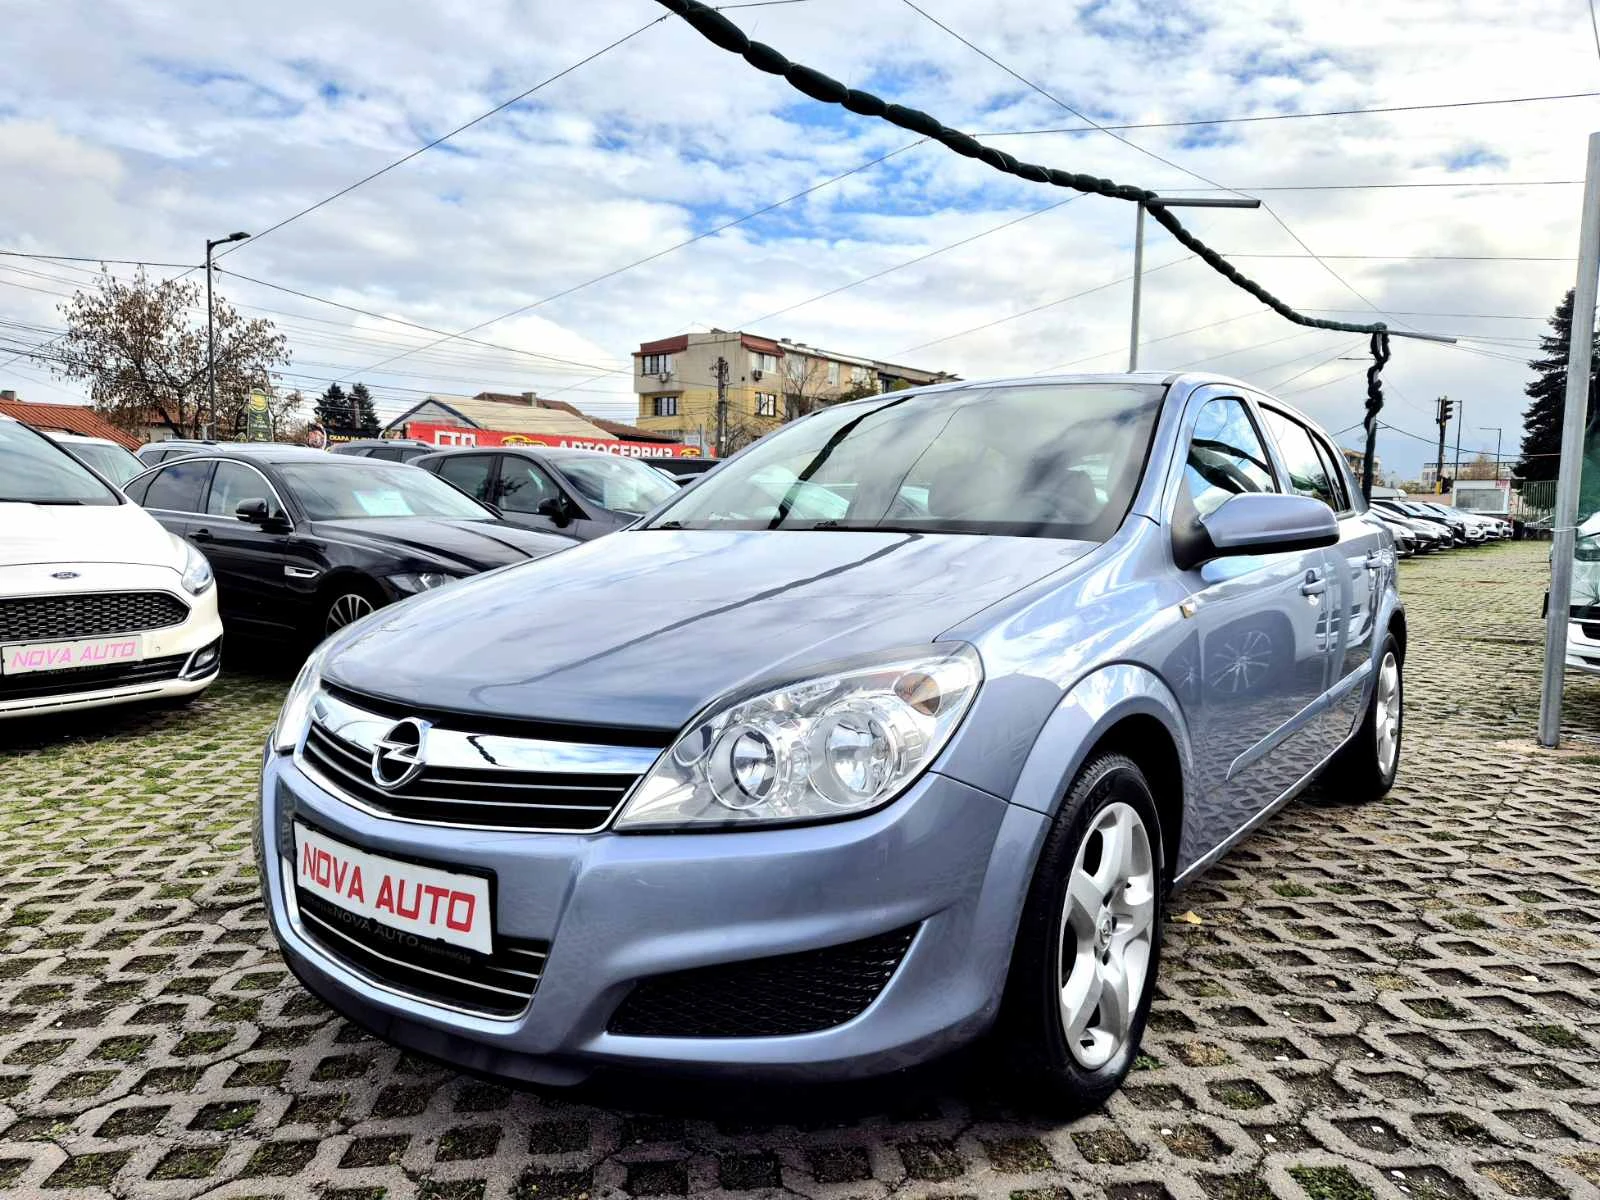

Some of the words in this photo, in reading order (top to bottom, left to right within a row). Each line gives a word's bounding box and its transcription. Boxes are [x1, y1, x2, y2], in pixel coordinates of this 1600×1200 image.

[12, 647, 72, 667] NOVA
[80, 641, 136, 661] AUTO
[302, 842, 365, 904] NOVA
[375, 875, 476, 933] AUTO
[374, 925, 420, 948] AUTO
